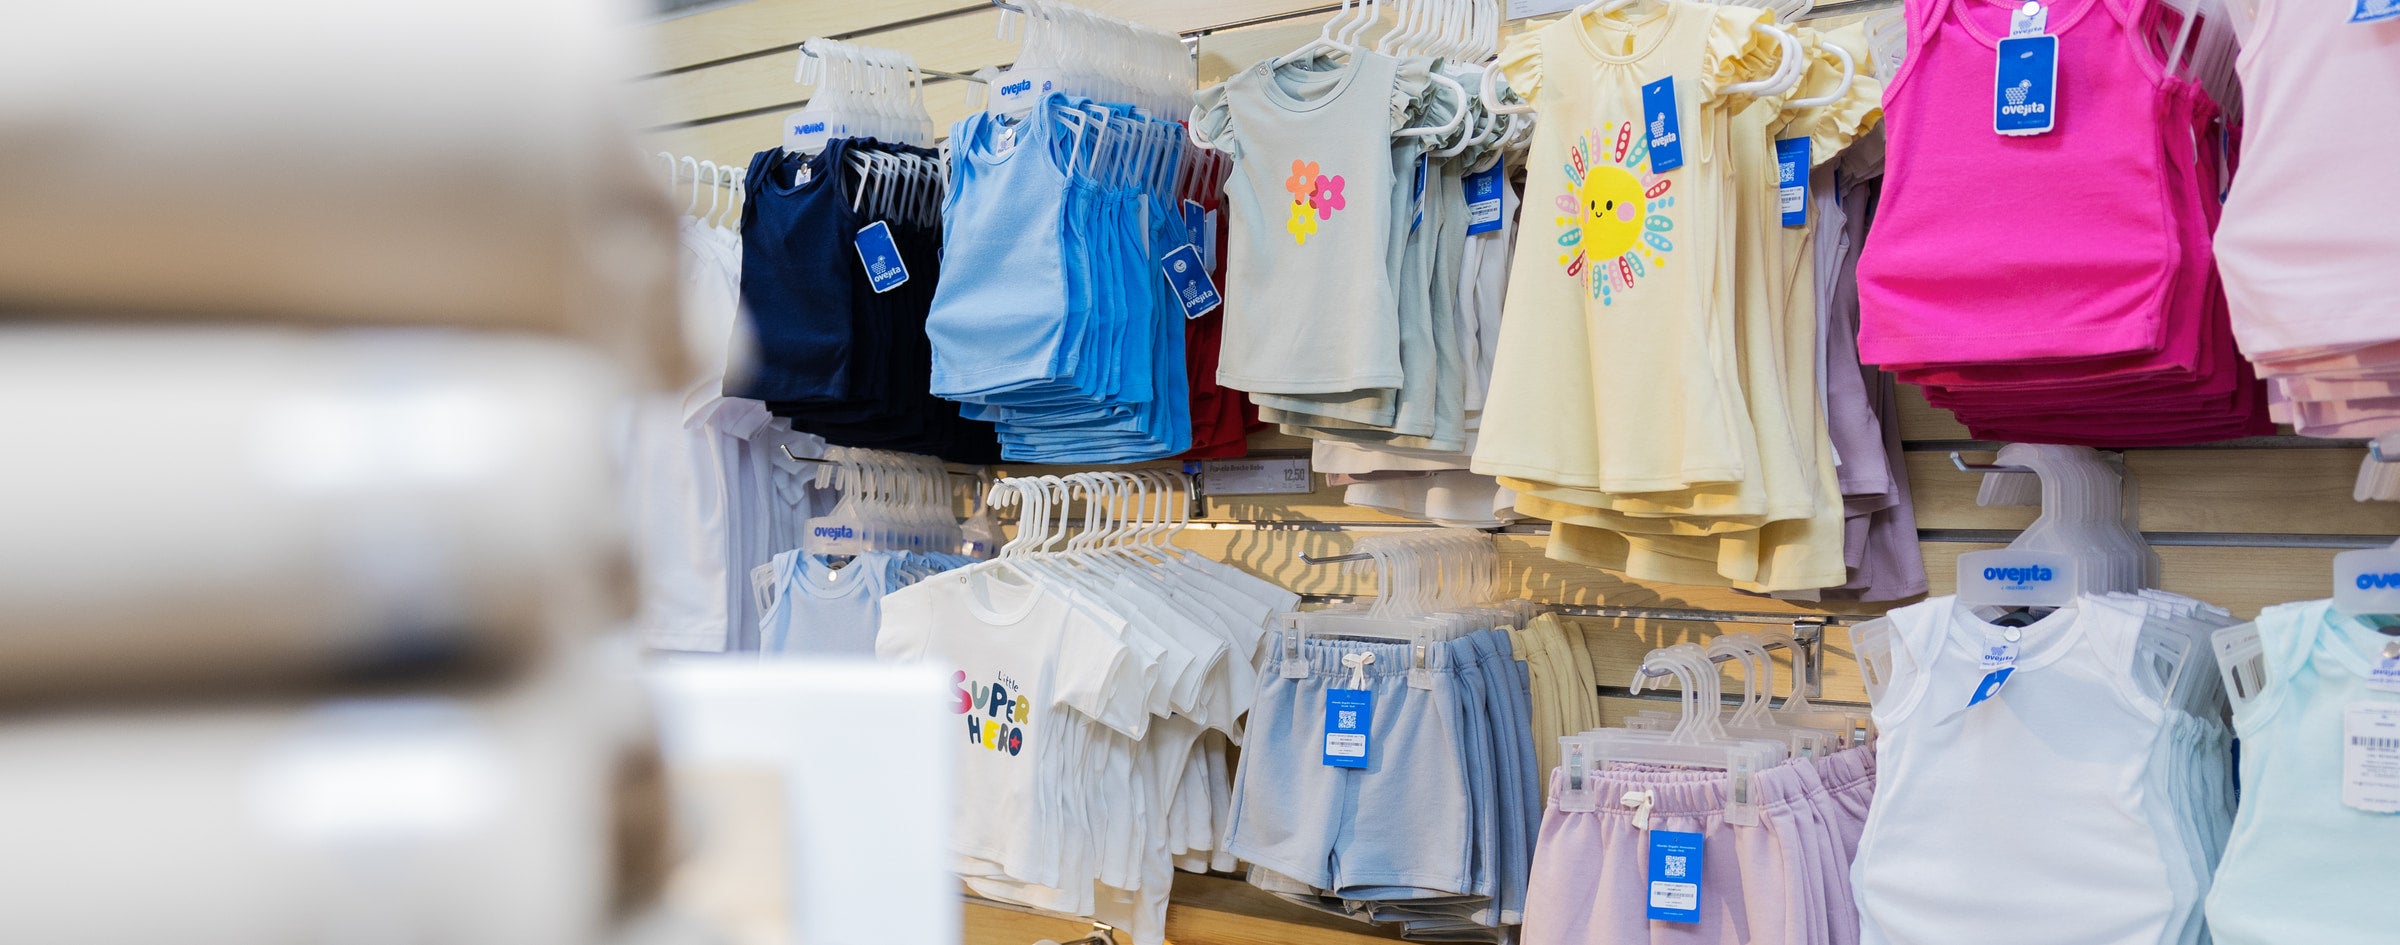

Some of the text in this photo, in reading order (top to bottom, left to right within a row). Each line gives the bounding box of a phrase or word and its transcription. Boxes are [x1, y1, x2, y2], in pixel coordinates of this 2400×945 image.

[1001, 79, 1031, 96] ovejita
[2002, 102, 2045, 116] ovejita
[1651, 132, 1677, 148] ovejita
[874, 267, 902, 283] ovejita
[1186, 290, 1214, 309] ovejita
[814, 525, 853, 541] ovejita
[1984, 564, 2052, 585] ovejita
[998, 670, 1019, 692] Little
[949, 670, 1030, 725] SUPER
[967, 714, 1023, 756] HERO
